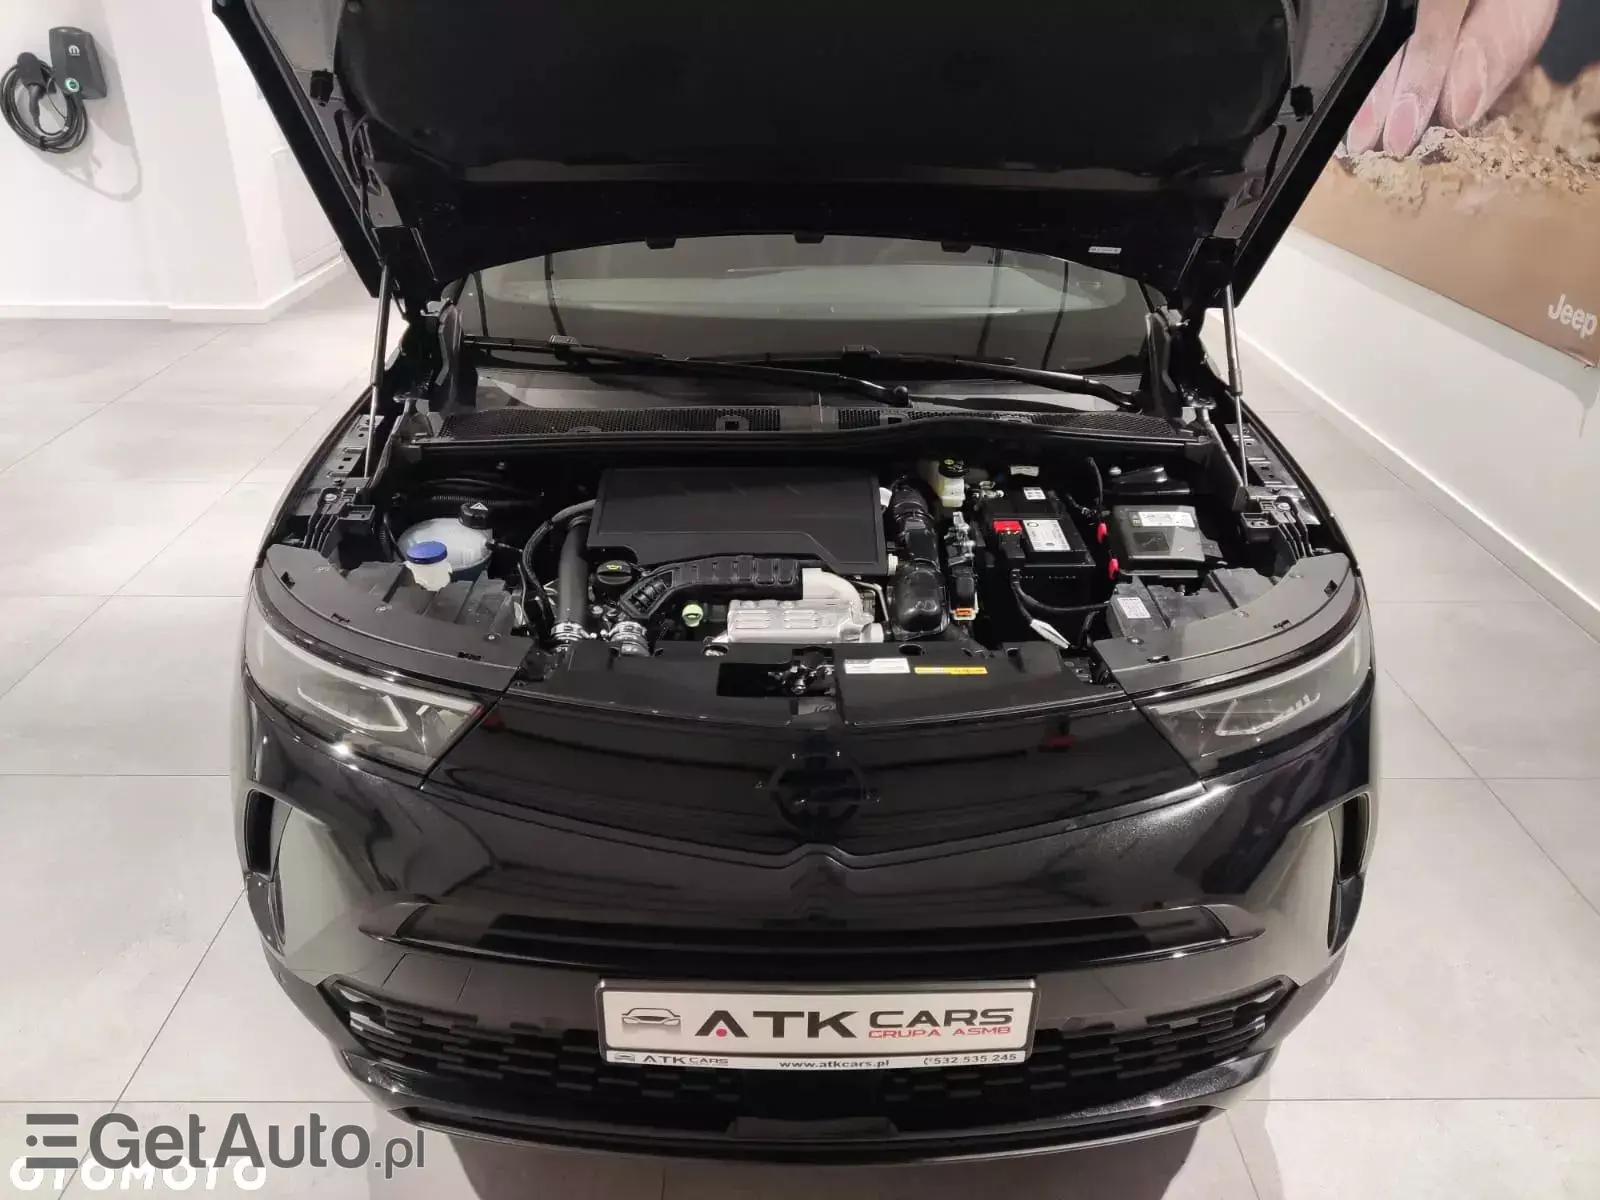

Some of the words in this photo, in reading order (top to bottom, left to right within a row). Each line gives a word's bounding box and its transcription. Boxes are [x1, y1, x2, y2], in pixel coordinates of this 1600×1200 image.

[1547, 293, 1598, 339] Jeep
[694, 1010, 859, 1039] ATK
[869, 1008, 1014, 1028] CARS
[868, 1028, 942, 1039] GRUPA
[952, 1027, 1011, 1036] ASMB
[643, 1055, 687, 1065] ATK
[689, 1057, 729, 1065] CARS
[963, 1055, 988, 1064] 535
[992, 1053, 1017, 1062] 245
[779, 1060, 890, 1069] www.atkcars.pl
